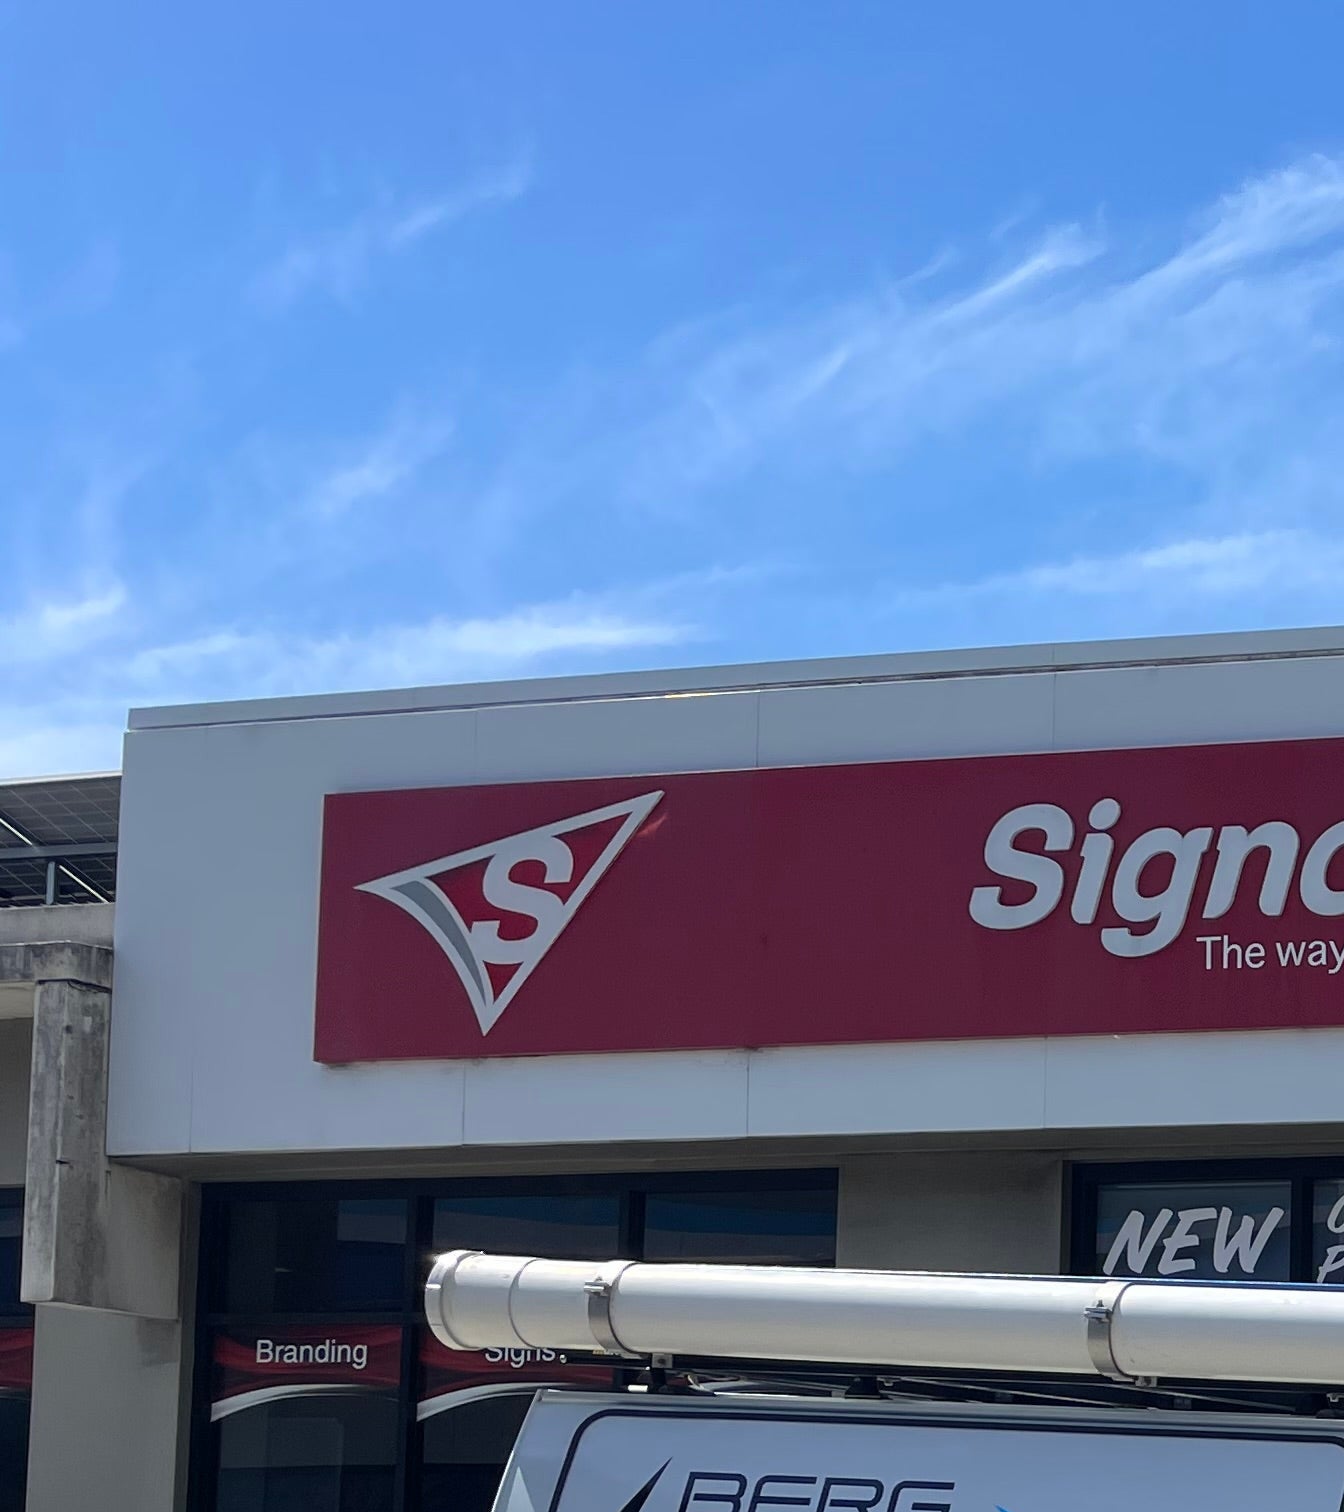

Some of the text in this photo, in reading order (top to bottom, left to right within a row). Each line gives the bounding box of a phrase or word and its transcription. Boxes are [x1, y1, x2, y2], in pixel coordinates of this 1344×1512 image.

[1197, 935, 1265, 971] The
[1103, 1207, 1284, 1275] NEW
[256, 1339, 367, 1370] Branding
